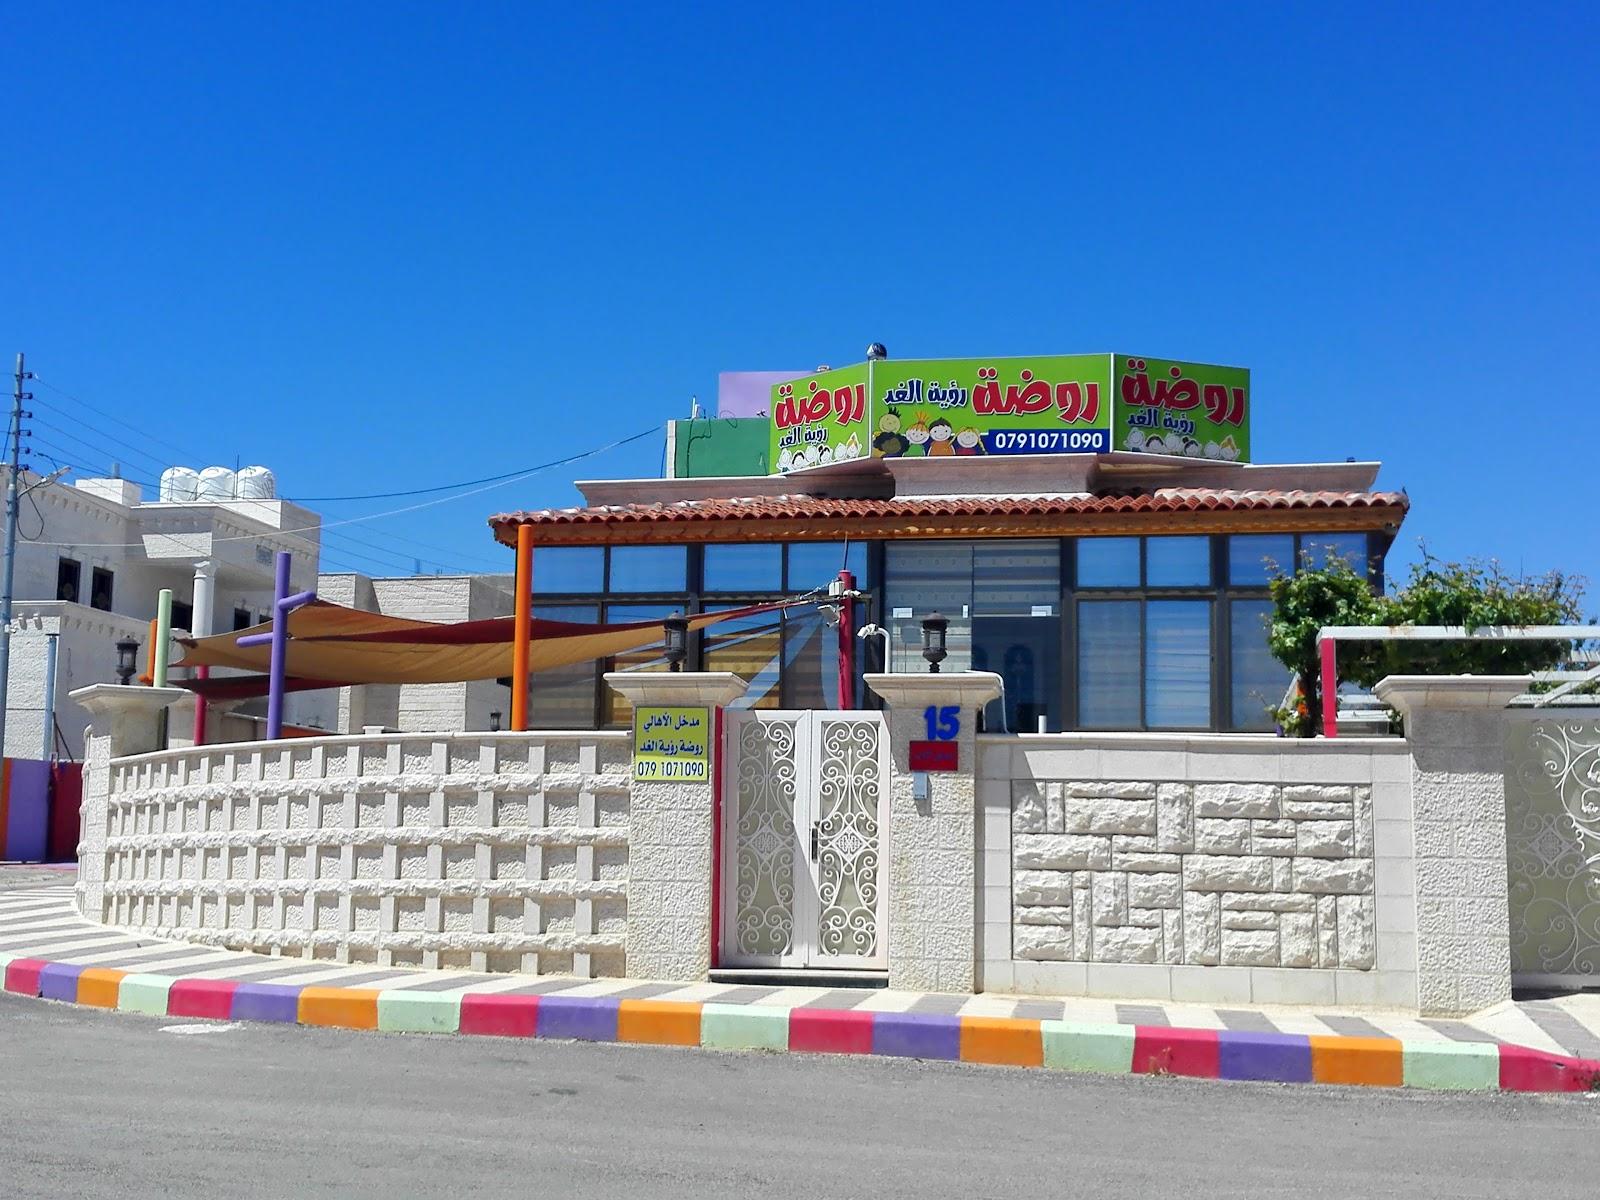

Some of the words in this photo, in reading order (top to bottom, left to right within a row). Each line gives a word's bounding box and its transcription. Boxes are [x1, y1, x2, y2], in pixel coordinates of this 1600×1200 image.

[883, 379, 923, 404] الغد
[927, 380, 967, 409] رؤية
[972, 367, 1100, 424] روضة
[1121, 359, 1245, 426] روضة
[775, 381, 865, 429] روضة
[1128, 408, 1159, 427] الغد
[780, 427, 801, 448] الغد
[995, 432, 1103, 449] 0791071090
[674, 714, 700, 731] مدخل
[924, 705, 961, 741] 15
[639, 739, 658, 752] الغد
[680, 739, 704, 755] روضة
